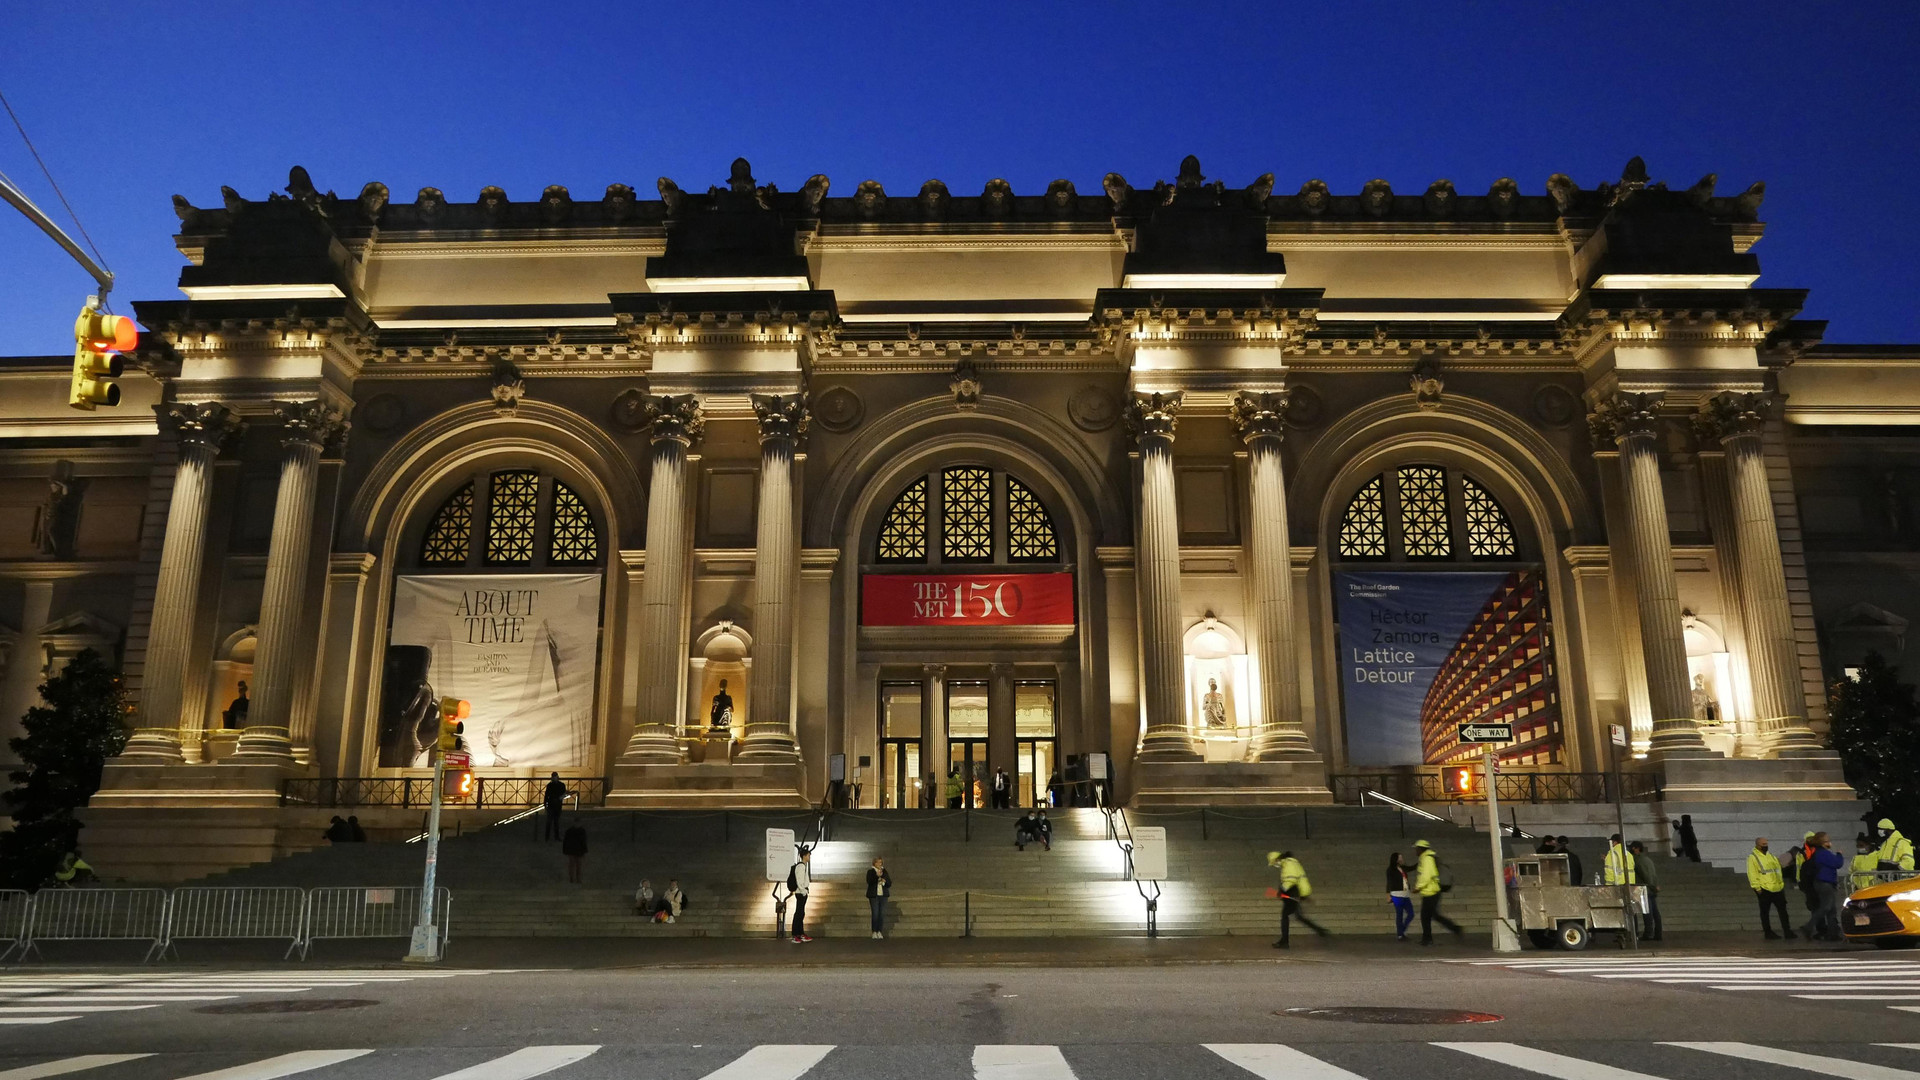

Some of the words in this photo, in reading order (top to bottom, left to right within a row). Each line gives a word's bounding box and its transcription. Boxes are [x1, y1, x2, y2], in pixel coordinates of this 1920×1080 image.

[913, 582, 948, 599] THE
[455, 589, 539, 617] ABOUT
[950, 581, 1023, 618] 150
[913, 600, 948, 618] MET
[1370, 608, 1429, 624] Héctor
[464, 617, 525, 644] TIME
[1372, 628, 1440, 644] Zamora
[477, 653, 508, 661] FASHION
[1353, 647, 1416, 664] Lattice
[1355, 667, 1416, 684] Detour
[1466, 729, 1483, 737] ONE
[1488, 729, 1505, 737] WAY
[461, 773, 471, 793] 2
[1460, 770, 1469, 790] 2
